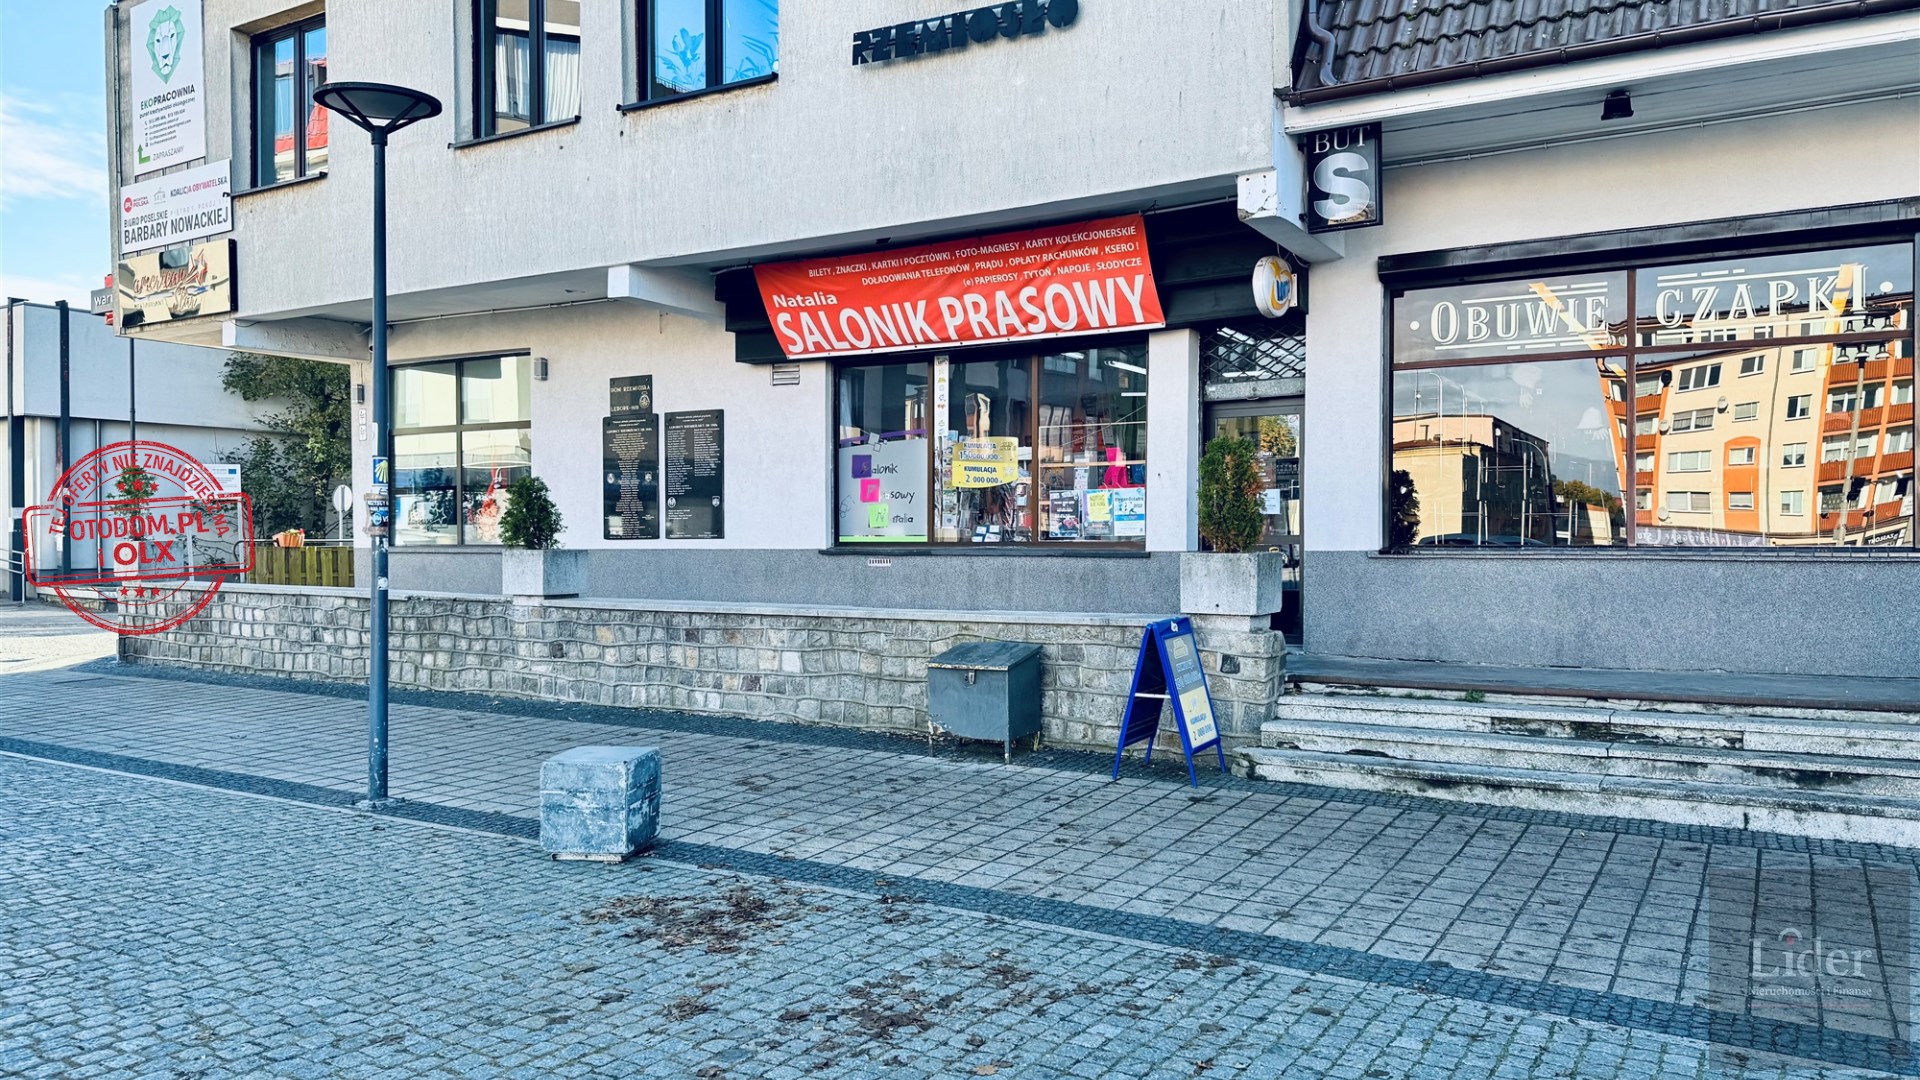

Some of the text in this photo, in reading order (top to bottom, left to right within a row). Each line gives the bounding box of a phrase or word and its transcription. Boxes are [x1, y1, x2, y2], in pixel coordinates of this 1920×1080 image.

[141, 84, 196, 110] EKOPRACOWNIA
[153, 146, 184, 161] ZAPRASZAMY
[1313, 125, 1370, 154] BUT
[170, 176, 227, 197] KOALICJA OBYWATELSKA
[1313, 152, 1370, 221] S
[124, 210, 168, 228] BIURO POSELSKIE
[124, 207, 229, 244] BARBARY NOWACKIEJ
[809, 267, 831, 277] BILETY
[836, 264, 867, 274] ZNACZKI
[871, 259, 899, 270] KARTKI
[904, 251, 950, 265] POCZTÓWKI
[955, 241, 1020, 258] FOTO-MAGNESY
[1025, 237, 1053, 249] KARTY
[1055, 226, 1136, 245] KOLEKCJONERSKIE
[862, 243, 1135, 286] DOŁADOWANIA TELEFONÓW PRĄDU OPŁATY RACHUNKÓW KSERO
[963, 257, 1142, 287] (e) PAPIEROSY TYTOŃ NAPOJE SŁODYCZE
[772, 292, 838, 308] Natalia
[777, 274, 1145, 353] SALONIK PRASOWY
[1430, 263, 1869, 345] OBUWIE CZAPKI
[964, 466, 997, 474] KUMULACJA
[965, 474, 970, 483] 2
